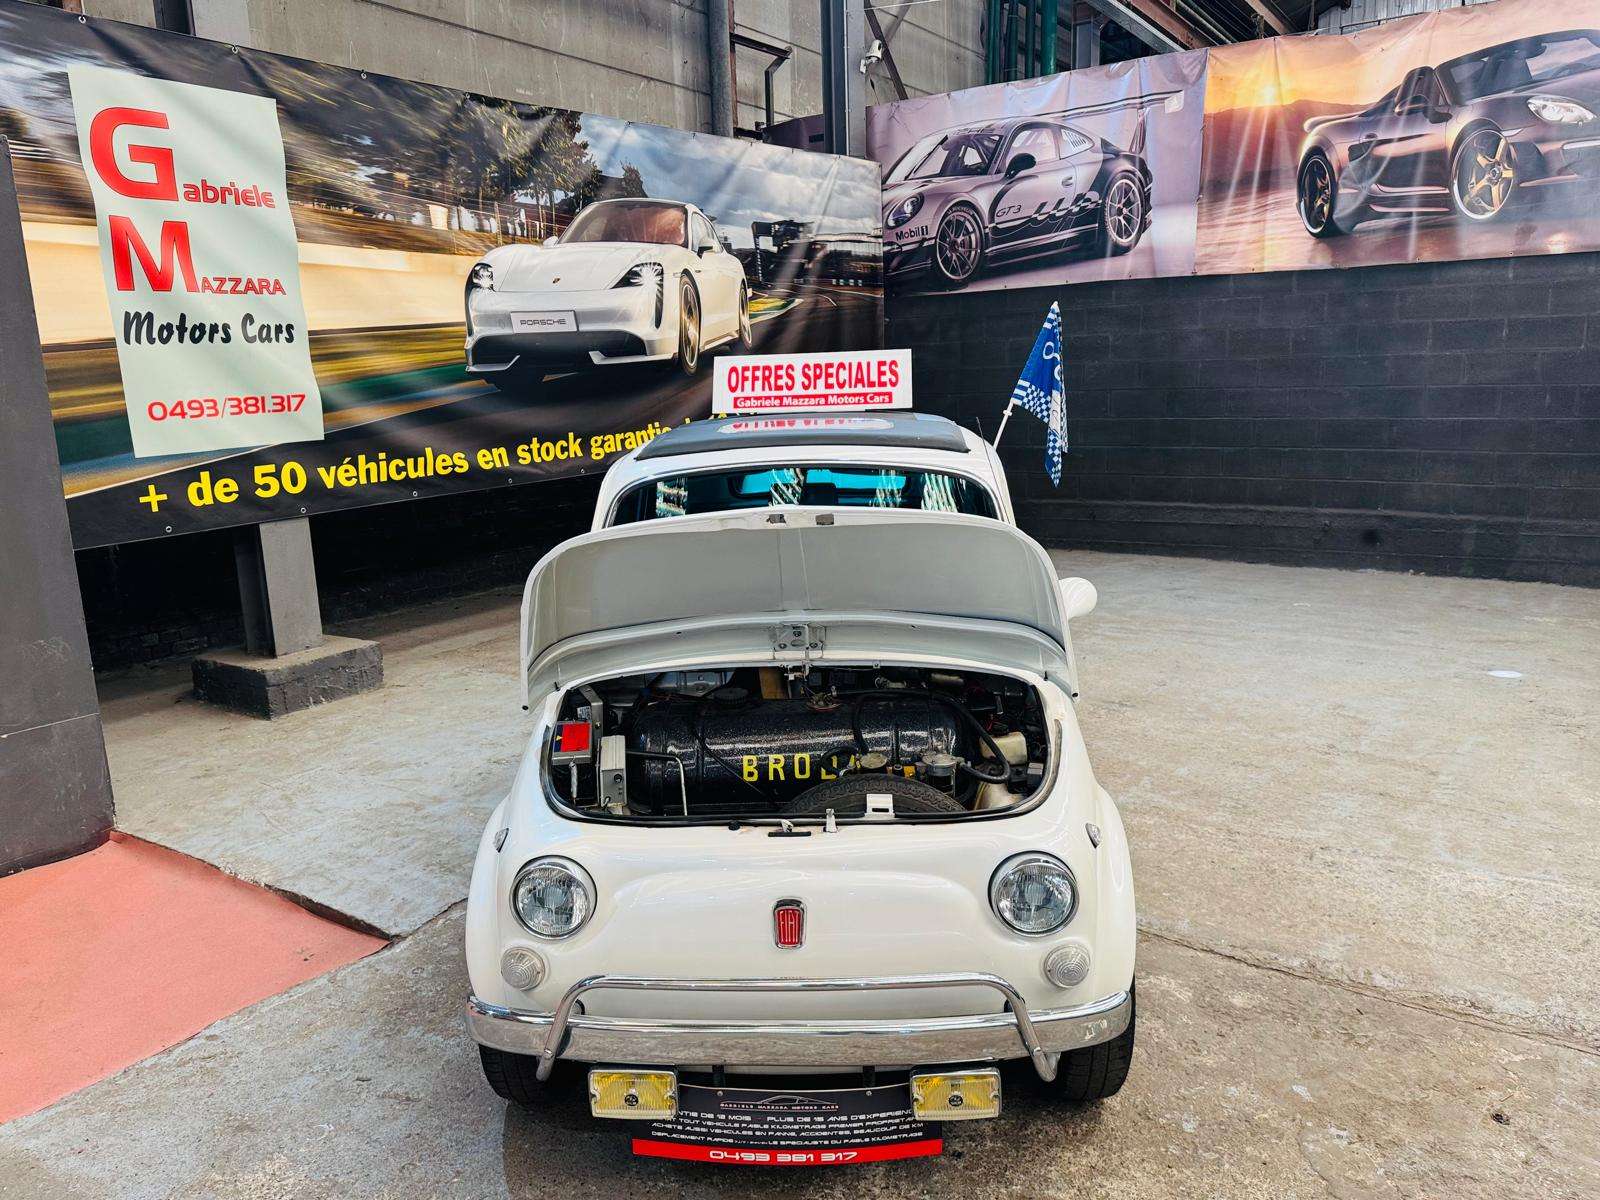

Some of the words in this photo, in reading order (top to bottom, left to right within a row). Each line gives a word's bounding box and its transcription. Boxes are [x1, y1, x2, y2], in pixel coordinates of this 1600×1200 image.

[90, 107, 276, 208] Gabriele
[996, 204, 1022, 218] GT3
[123, 310, 232, 345] Motors
[241, 313, 295, 344] Cars
[520, 318, 567, 326] PORSCHE
[727, 363, 796, 393] OFFRES
[801, 359, 899, 391] SPECIALES
[147, 394, 306, 421] 0493/381.317
[736, 395, 781, 408] Gabriele
[783, 394, 825, 406] Mazzara
[828, 393, 865, 405] Motors
[866, 393, 890, 404] Cars
[187, 471, 239, 507] de
[254, 461, 307, 498] 50
[317, 447, 469, 489] véhicules
[477, 446, 510, 472] en
[516, 432, 584, 465] stock
[651, 1122, 683, 1130] ACHETE
[709, 1128, 754, 1136] VEHICULES
[853, 1126, 898, 1135] BEAUCOUP
[701, 1120, 740, 1128] VEHICULE
[651, 1130, 706, 1141] DEPLACEMENT
[709, 1150, 771, 1162] 0493
[777, 1153, 815, 1162] 381
[821, 1151, 858, 1162] 317
